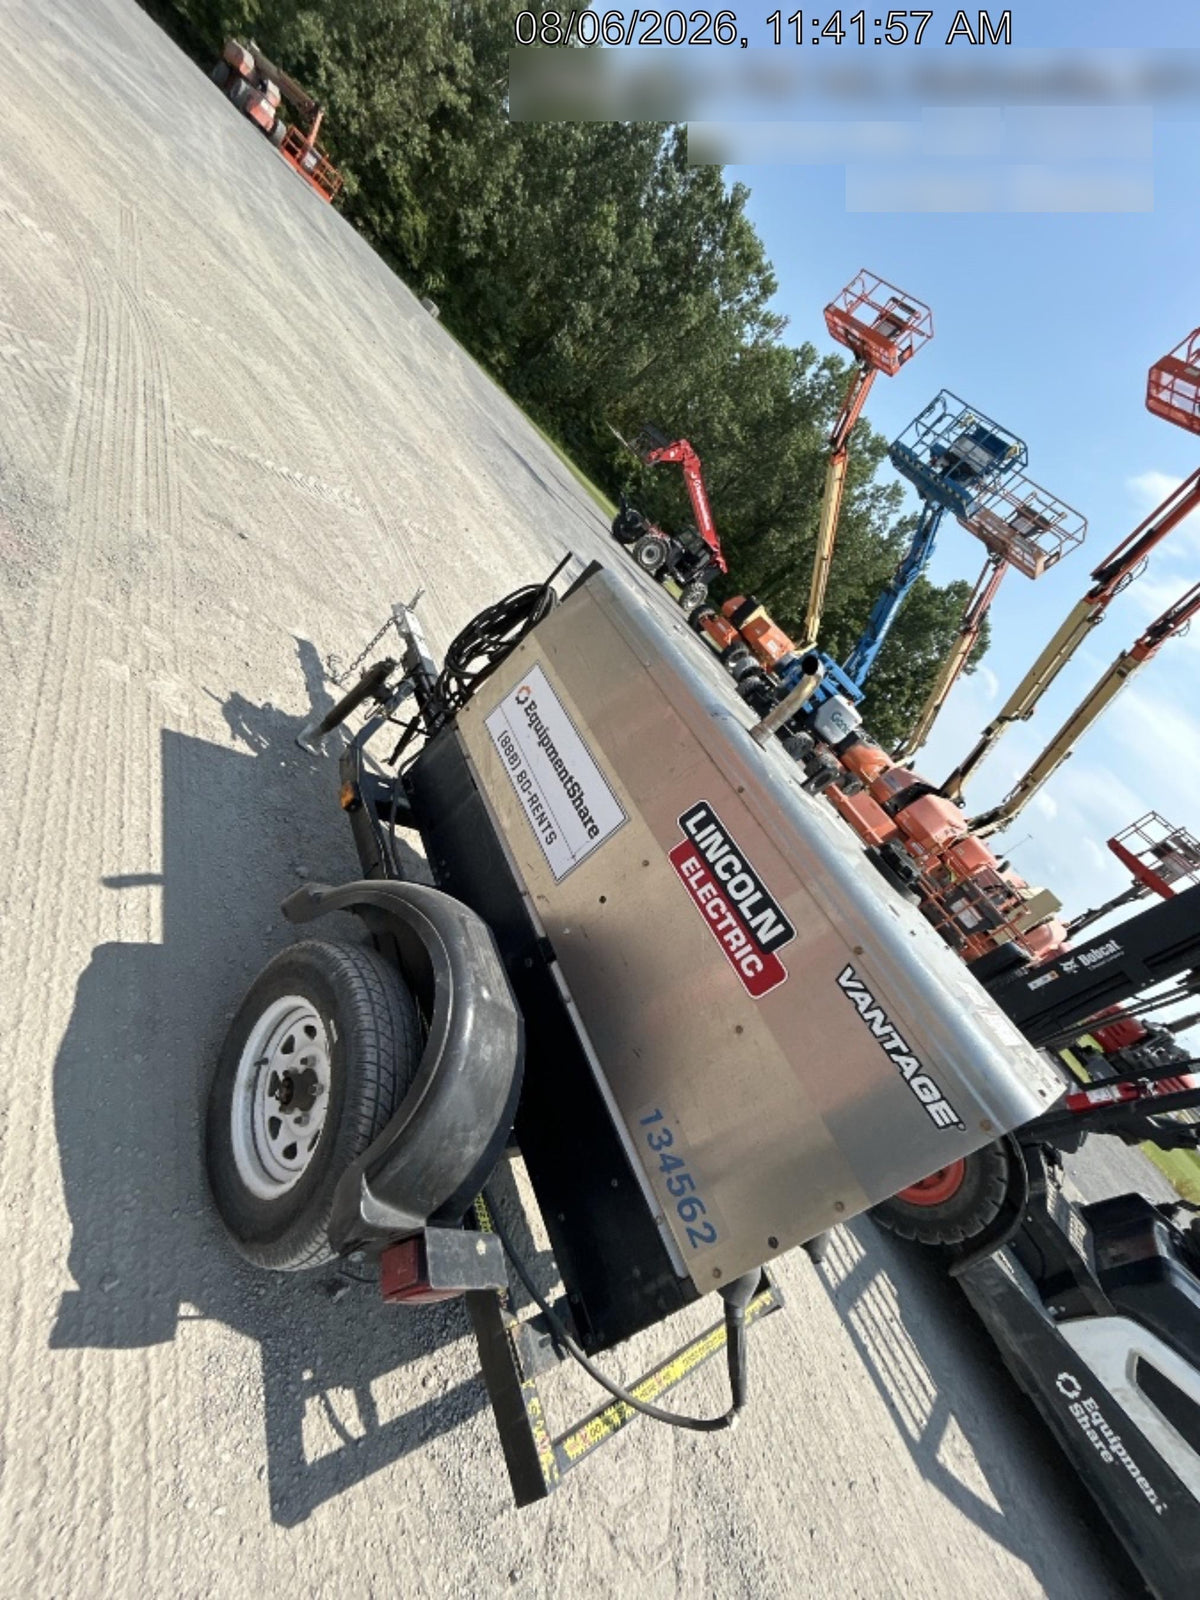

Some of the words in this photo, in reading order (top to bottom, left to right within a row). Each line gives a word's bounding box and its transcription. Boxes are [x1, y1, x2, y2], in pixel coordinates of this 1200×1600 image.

[497, 729, 519, 773] (888)
[516, 768, 558, 847] 80-RENTS
[523, 699, 601, 841] EquipmentShare
[679, 855, 764, 979] ELECTRIC
[685, 809, 787, 946] LINCOLN
[1077, 938, 1122, 967] Bobcat
[836, 962, 961, 1131] VANTAGE
[639, 1107, 719, 1250] 134562
[1068, 1401, 1115, 1465] Share
[1080, 1396, 1169, 1516] Equipment
